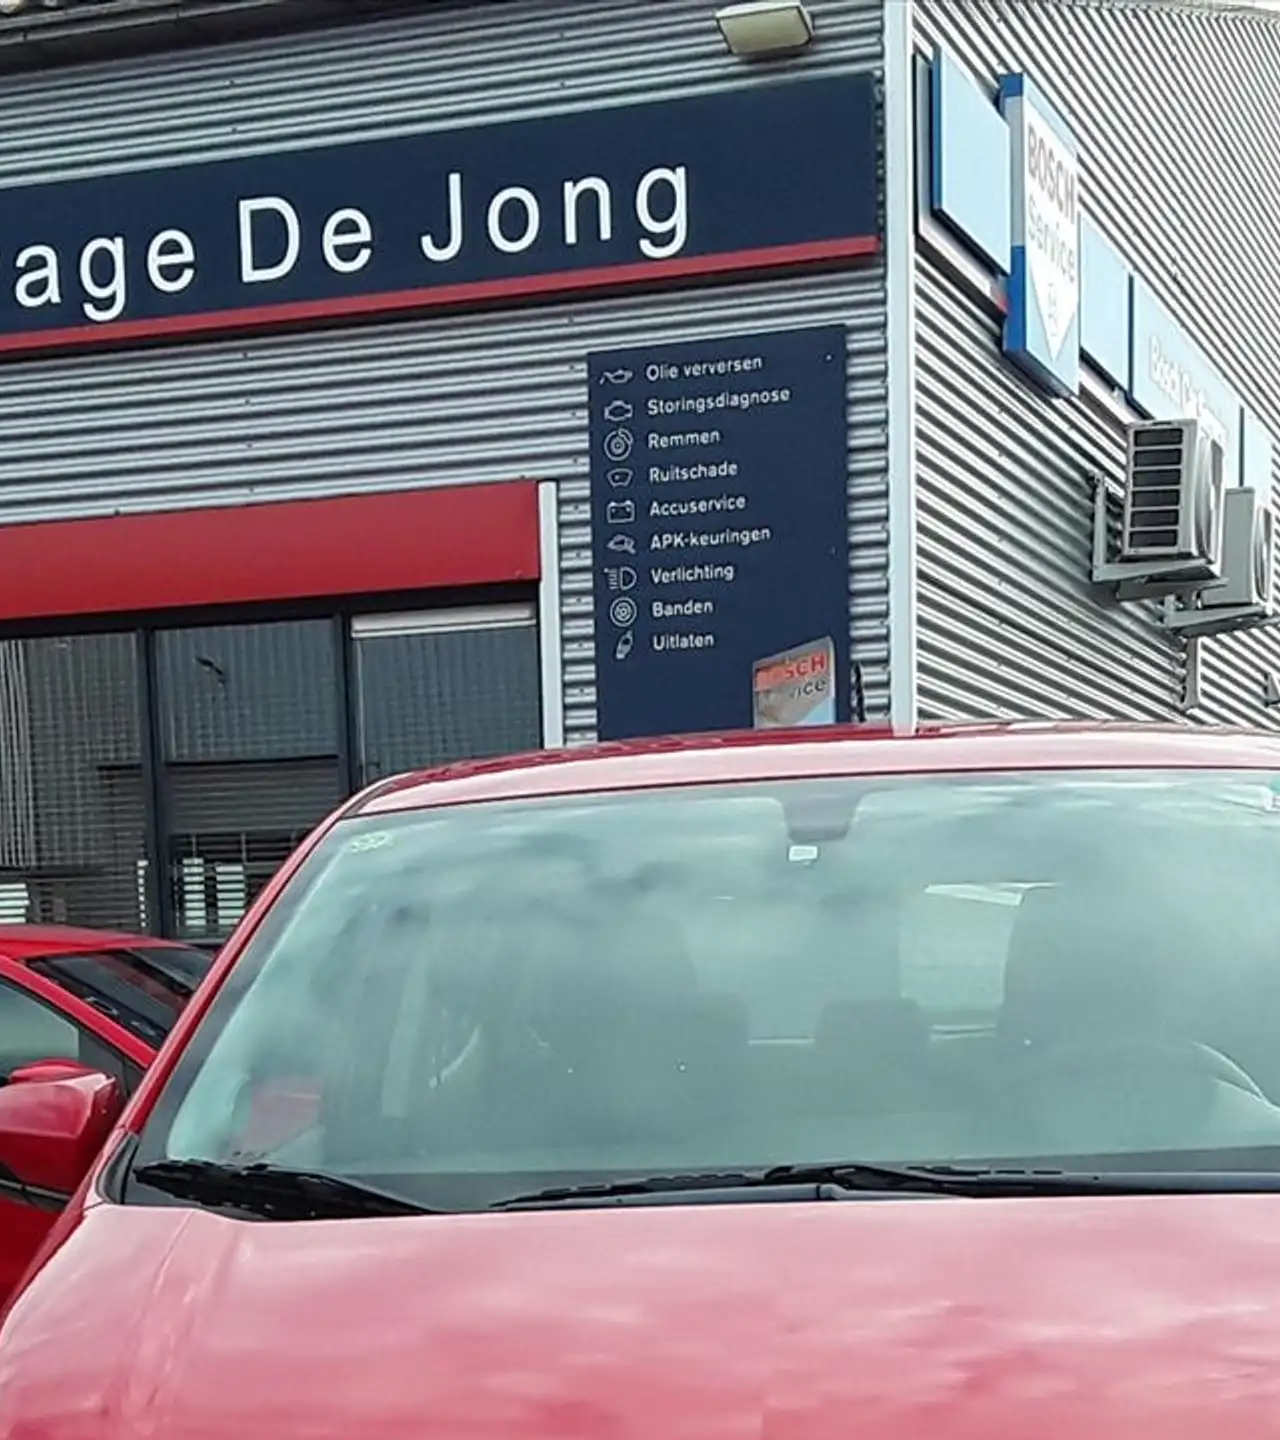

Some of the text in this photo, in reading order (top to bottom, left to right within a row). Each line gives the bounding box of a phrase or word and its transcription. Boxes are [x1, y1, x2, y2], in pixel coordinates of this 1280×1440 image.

[1027, 122, 1076, 225] BOSCH
[236, 194, 373, 283] De
[421, 163, 689, 260] Jong
[645, 356, 763, 381] Olie verversen
[647, 388, 791, 415] Storingsdiagnose
[647, 430, 721, 449] Remmen
[649, 460, 738, 483] Ruitschade
[649, 494, 747, 517] Accuservice
[650, 527, 771, 551] APK-keuringen
[650, 563, 735, 585] Verlichting
[651, 599, 714, 618] Banden
[652, 632, 715, 651] Uitlaten
